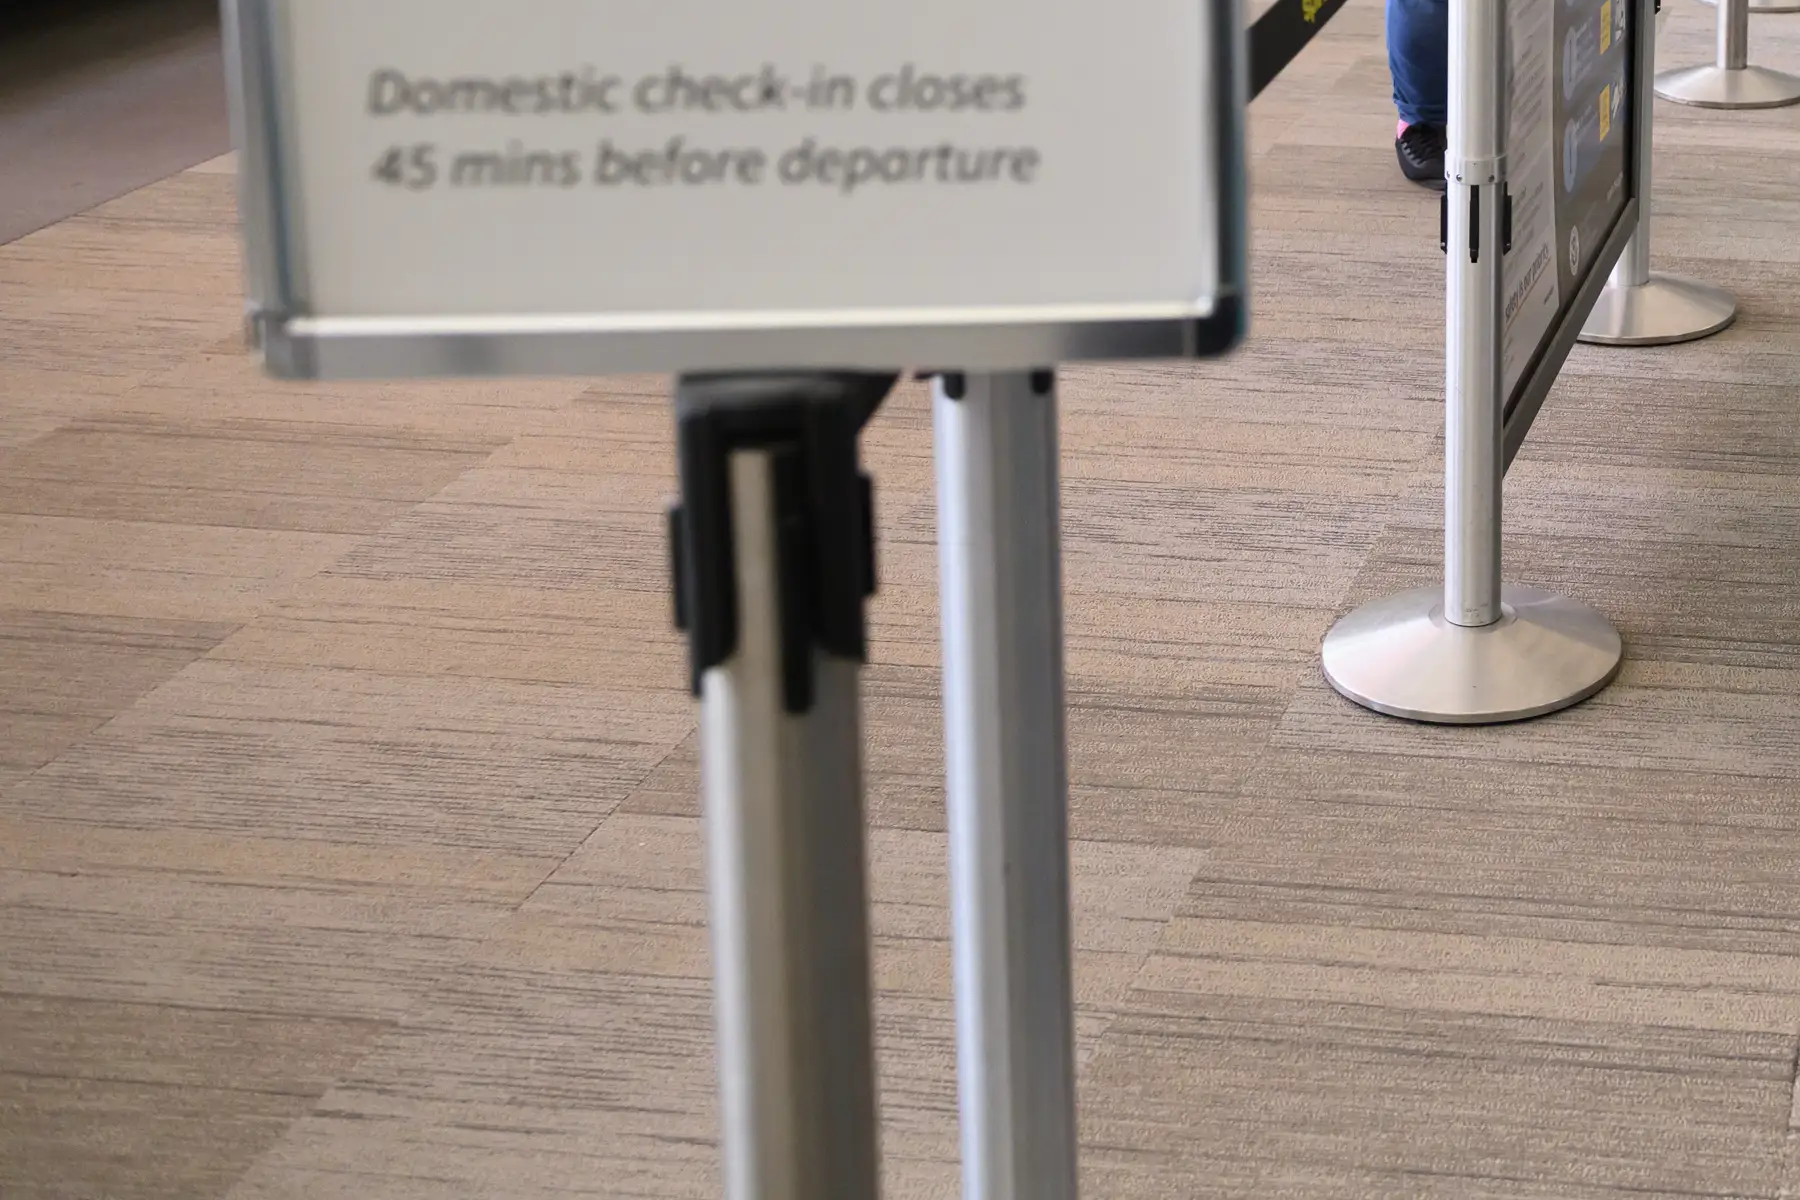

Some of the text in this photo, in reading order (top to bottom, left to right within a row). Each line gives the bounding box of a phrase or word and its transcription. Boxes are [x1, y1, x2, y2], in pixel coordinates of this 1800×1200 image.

[366, 63, 1029, 118] Domestic check-in closes
[372, 135, 1042, 194] 45 mins before departure
